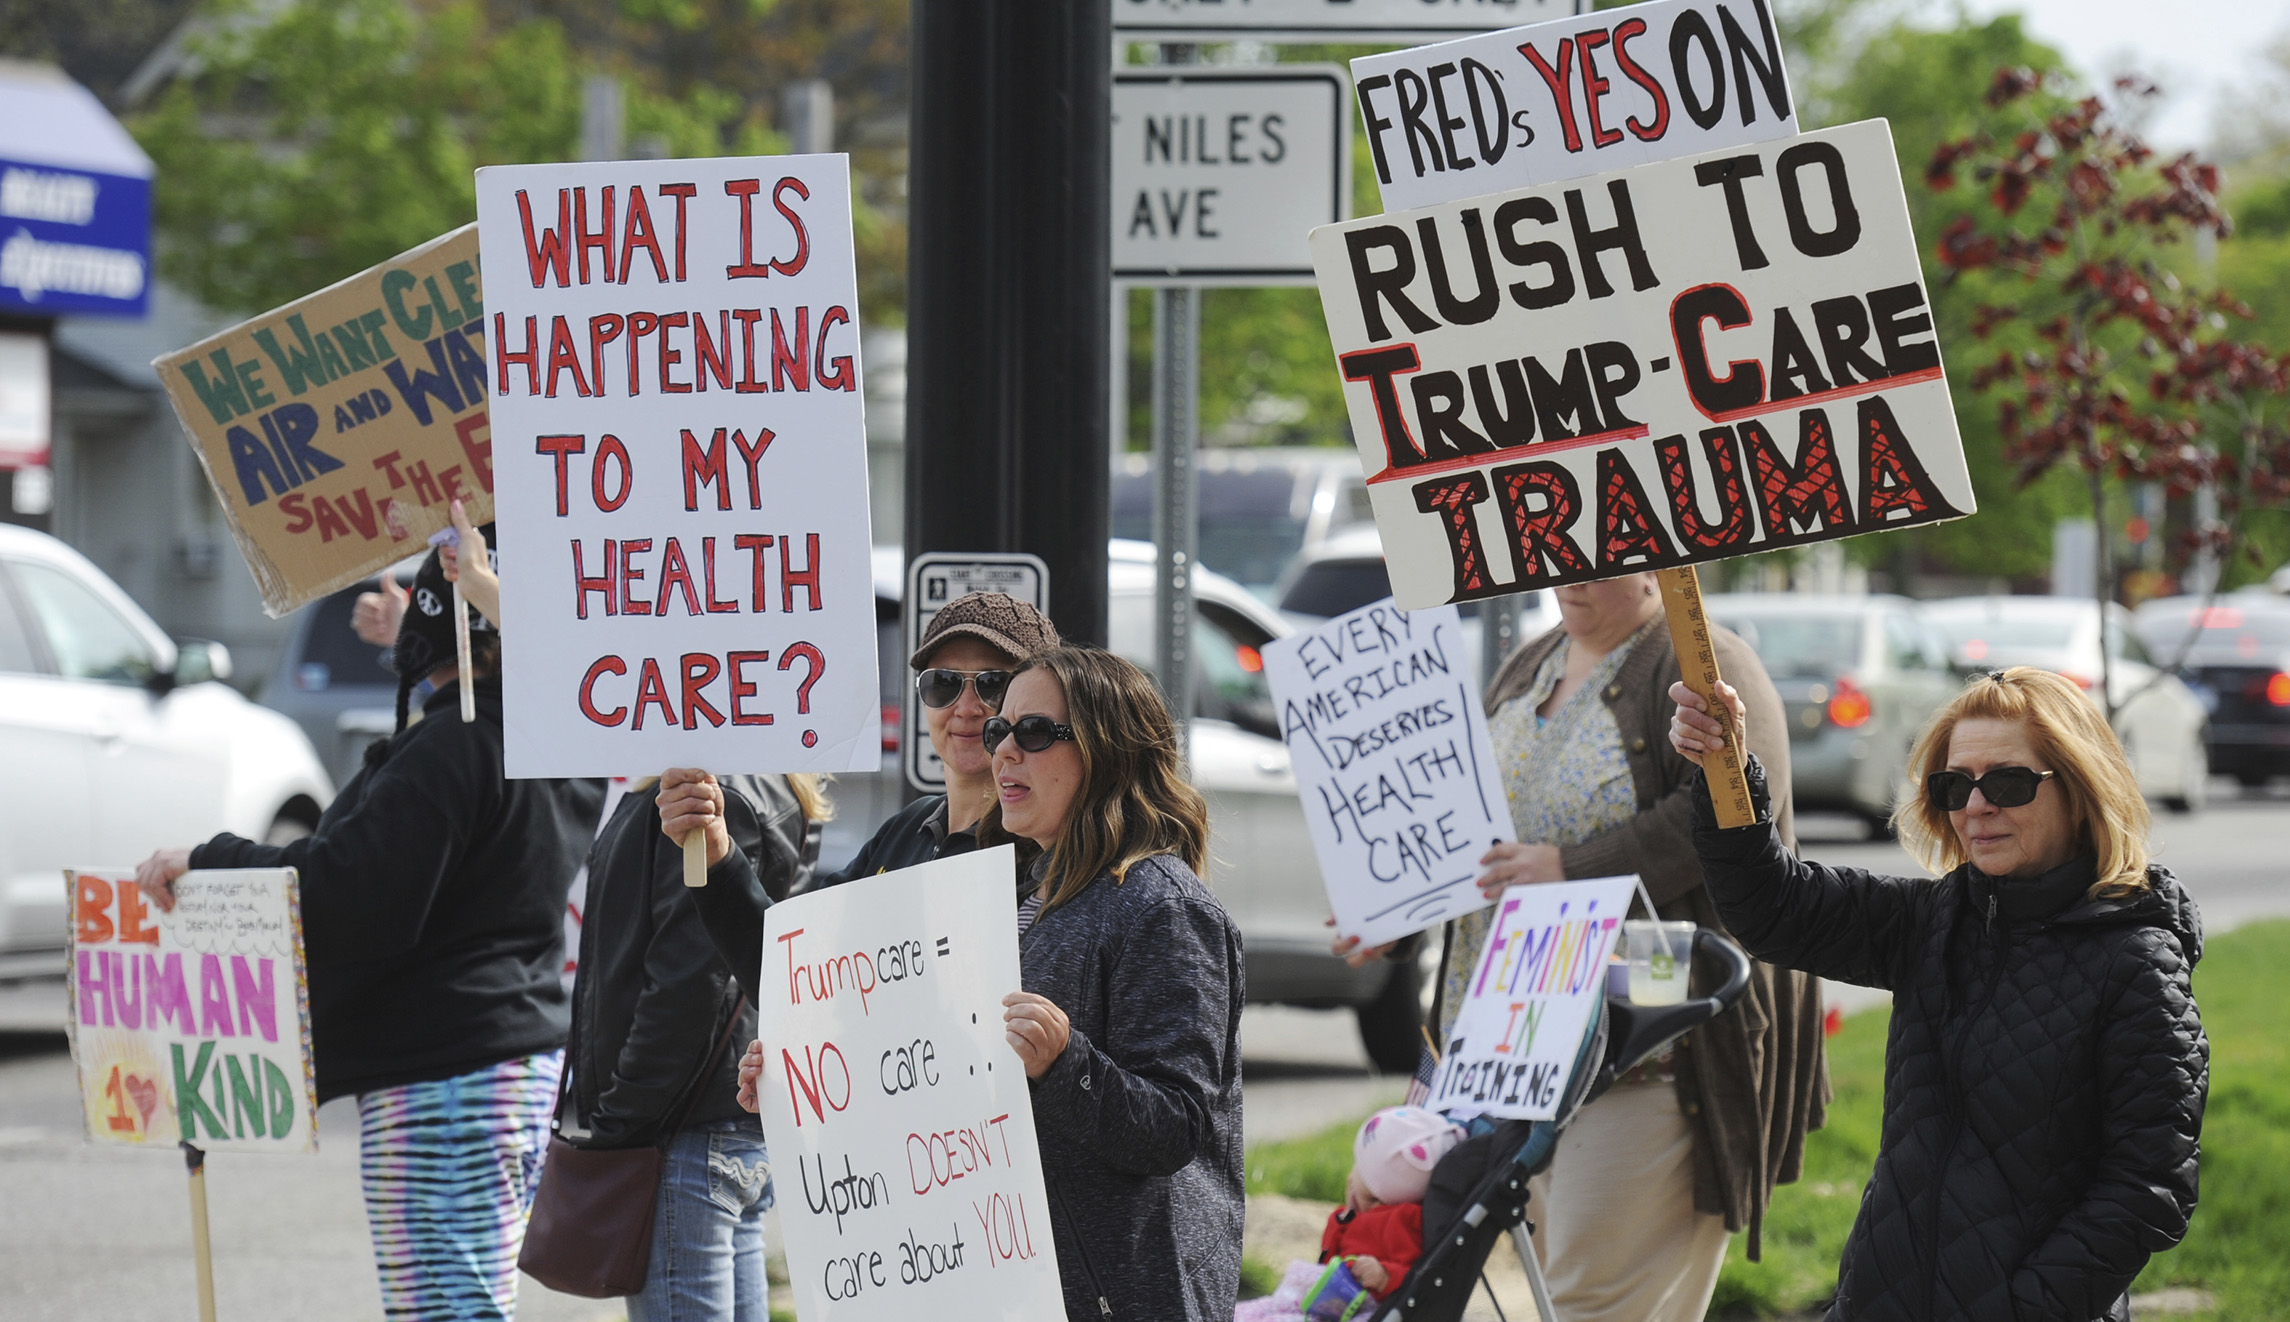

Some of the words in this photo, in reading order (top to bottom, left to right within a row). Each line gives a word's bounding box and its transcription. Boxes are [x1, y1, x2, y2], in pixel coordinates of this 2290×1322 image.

[1516, 17, 1670, 153] YES
[1668, 0, 1790, 131] ON
[1144, 113, 1288, 165] NILES
[515, 182, 697, 288] WHAT
[724, 176, 810, 280] IS
[1128, 189, 1220, 239] AVE
[1344, 178, 1661, 343] RUSH
[1694, 141, 1862, 271] TO
[180, 347, 276, 425] WE
[251, 313, 396, 396] WANT
[382, 253, 484, 341] CLE
[494, 305, 856, 398] HAPPENING
[226, 403, 345, 506] AIR
[334, 388, 392, 433] AND
[372, 450, 474, 506] THE
[536, 433, 633, 517] TO
[680, 427, 776, 511] MY
[1412, 395, 1974, 604] TRAUMA
[570, 533, 823, 620] HEALTH
[1298, 606, 1411, 680] EVERY
[578, 641, 826, 748] CARE?
[1282, 625, 1450, 769] AMERICAN
[1326, 699, 1454, 770] DESERVES
[1318, 740, 1465, 845] HEALTH
[76, 875, 160, 947] BE
[76, 950, 278, 1043] HUMAN
[777, 928, 925, 1016] Trumpcare
[1495, 1001, 1545, 1057] IN
[170, 1040, 295, 1141] KIND
[781, 1041, 851, 1127] NO
[879, 1038, 939, 1096] care
[799, 1152, 890, 1236] Upton
[906, 1113, 1012, 1196] DOESN'T
[824, 1249, 887, 1302] care
[898, 1221, 965, 1286] about
